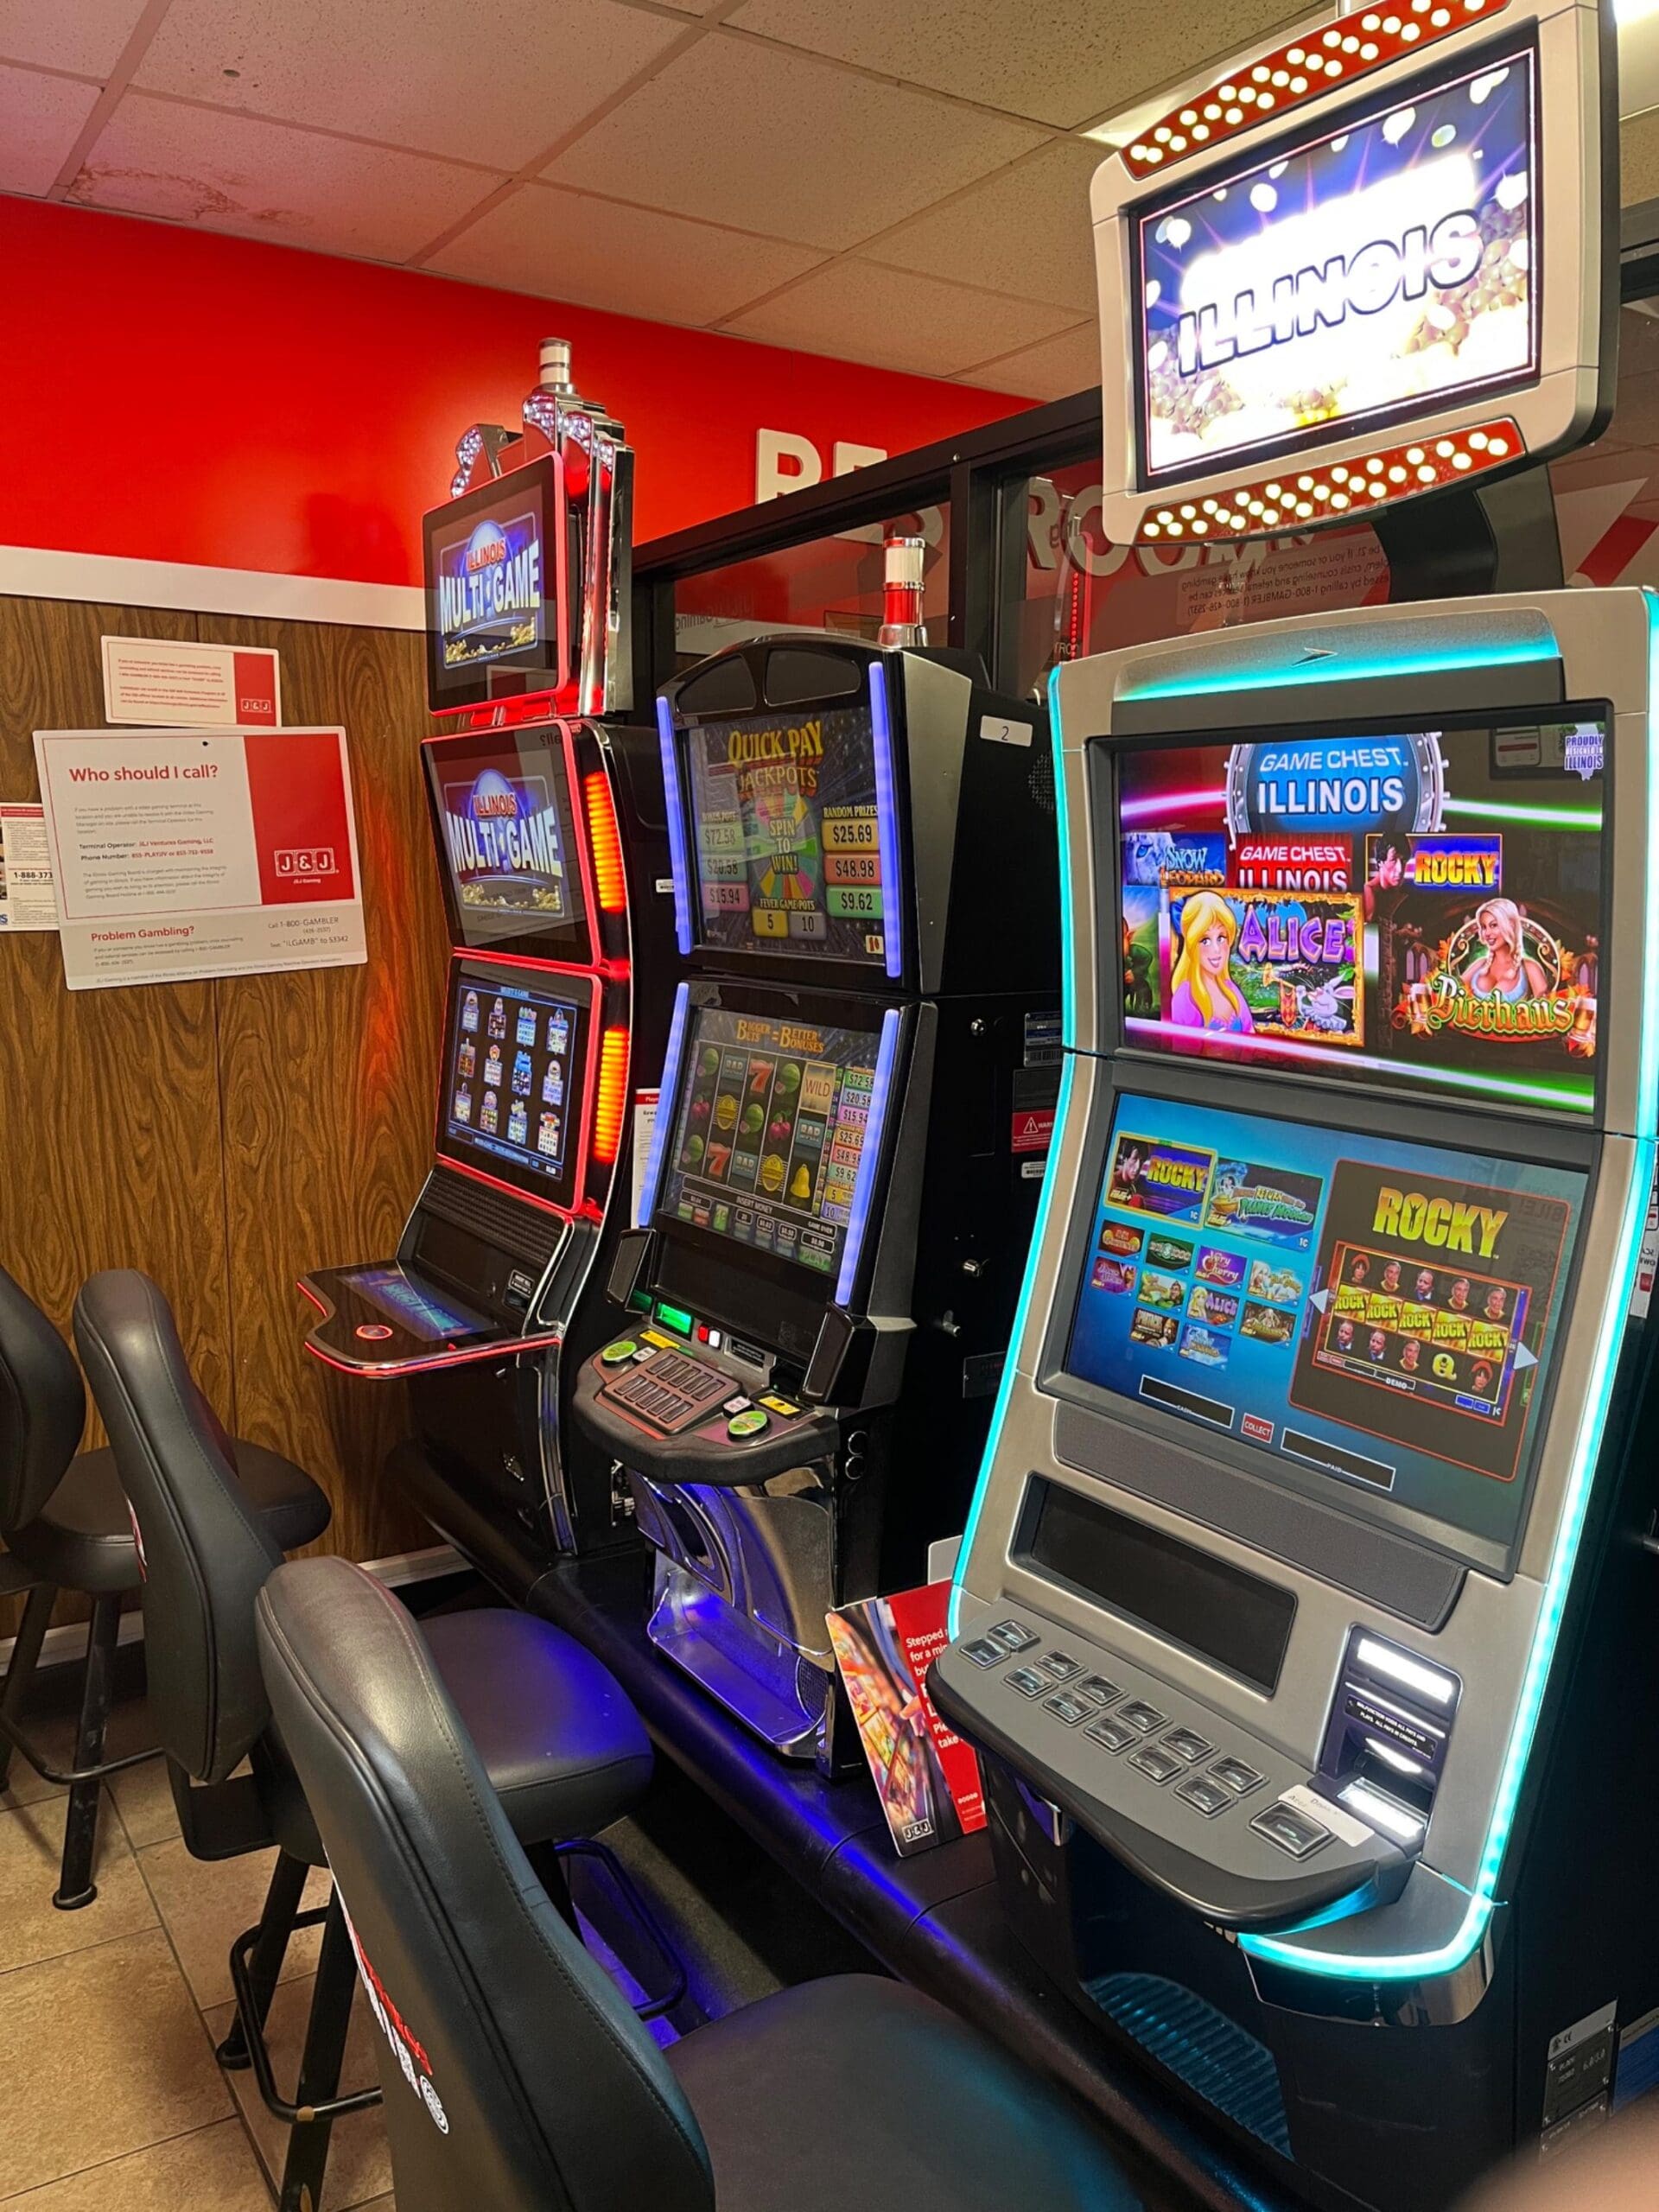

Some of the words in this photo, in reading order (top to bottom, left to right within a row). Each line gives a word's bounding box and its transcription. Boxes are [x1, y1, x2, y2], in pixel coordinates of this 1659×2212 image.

[1177, 209, 1483, 378] ILLINOIS
[467, 537, 506, 571] ILLINOIS
[440, 573, 484, 636] MULTI
[493, 539, 540, 613] GAME
[1000, 726, 1010, 742] 2
[1566, 735, 1604, 747] PROUDLY
[728, 731, 784, 769] QUICK
[787, 721, 823, 757] PAY
[1259, 751, 1322, 772] GAME
[1329, 747, 1403, 770] CHEST
[1565, 755, 1603, 769] ILLINOIS
[69, 767, 109, 782] Who
[114, 766, 169, 781] should
[174, 766, 179, 779] I
[182, 764, 218, 779] call?
[741, 766, 817, 792] JACKPOTS
[473, 792, 516, 817] ILLINOIS
[1257, 777, 1405, 815] ILLINOIS
[823, 806, 853, 818] RANDOM
[854, 804, 878, 817] PRIZES
[769, 820, 796, 836] SPIN
[833, 824, 872, 843] $25.69
[446, 810, 501, 873] MULTI
[505, 805, 563, 878] GAME
[776, 838, 791, 853] TO
[277, 851, 332, 874] J&J
[772, 853, 798, 874] WIN!
[1166, 846, 1207, 870] SNOW
[1240, 846, 1288, 862] GAME
[1290, 846, 1347, 862] CHEST
[836, 860, 874, 878] $48.98
[1160, 866, 1225, 886] LEOPARD
[1414, 851, 1497, 887] ROCKY
[1240, 868, 1347, 892] ILLINOIS
[709, 888, 741, 905] $15.94
[842, 892, 873, 911] $9.62
[767, 913, 774, 930] 5
[802, 916, 815, 932] 10
[91, 931, 136, 943] Problem
[138, 925, 195, 941] Gambling?
[1239, 905, 1346, 963] ALICE
[748, 1058, 774, 1094] 7
[805, 1077, 830, 1099] WILD
[708, 1141, 732, 1177] 7
[1147, 1157, 1208, 1193] ROCKY
[825, 1206, 835, 1218] 10
[1372, 1187, 1508, 1258] ROCKY
[1433, 1353, 1457, 1381] Q
[1386, 1377, 1407, 1389] DEMO
[1244, 1421, 1271, 1436] COLLECT
[906, 1628, 944, 1649] Stepped
[910, 1651, 924, 1662] for
[938, 1734, 959, 1749] take
